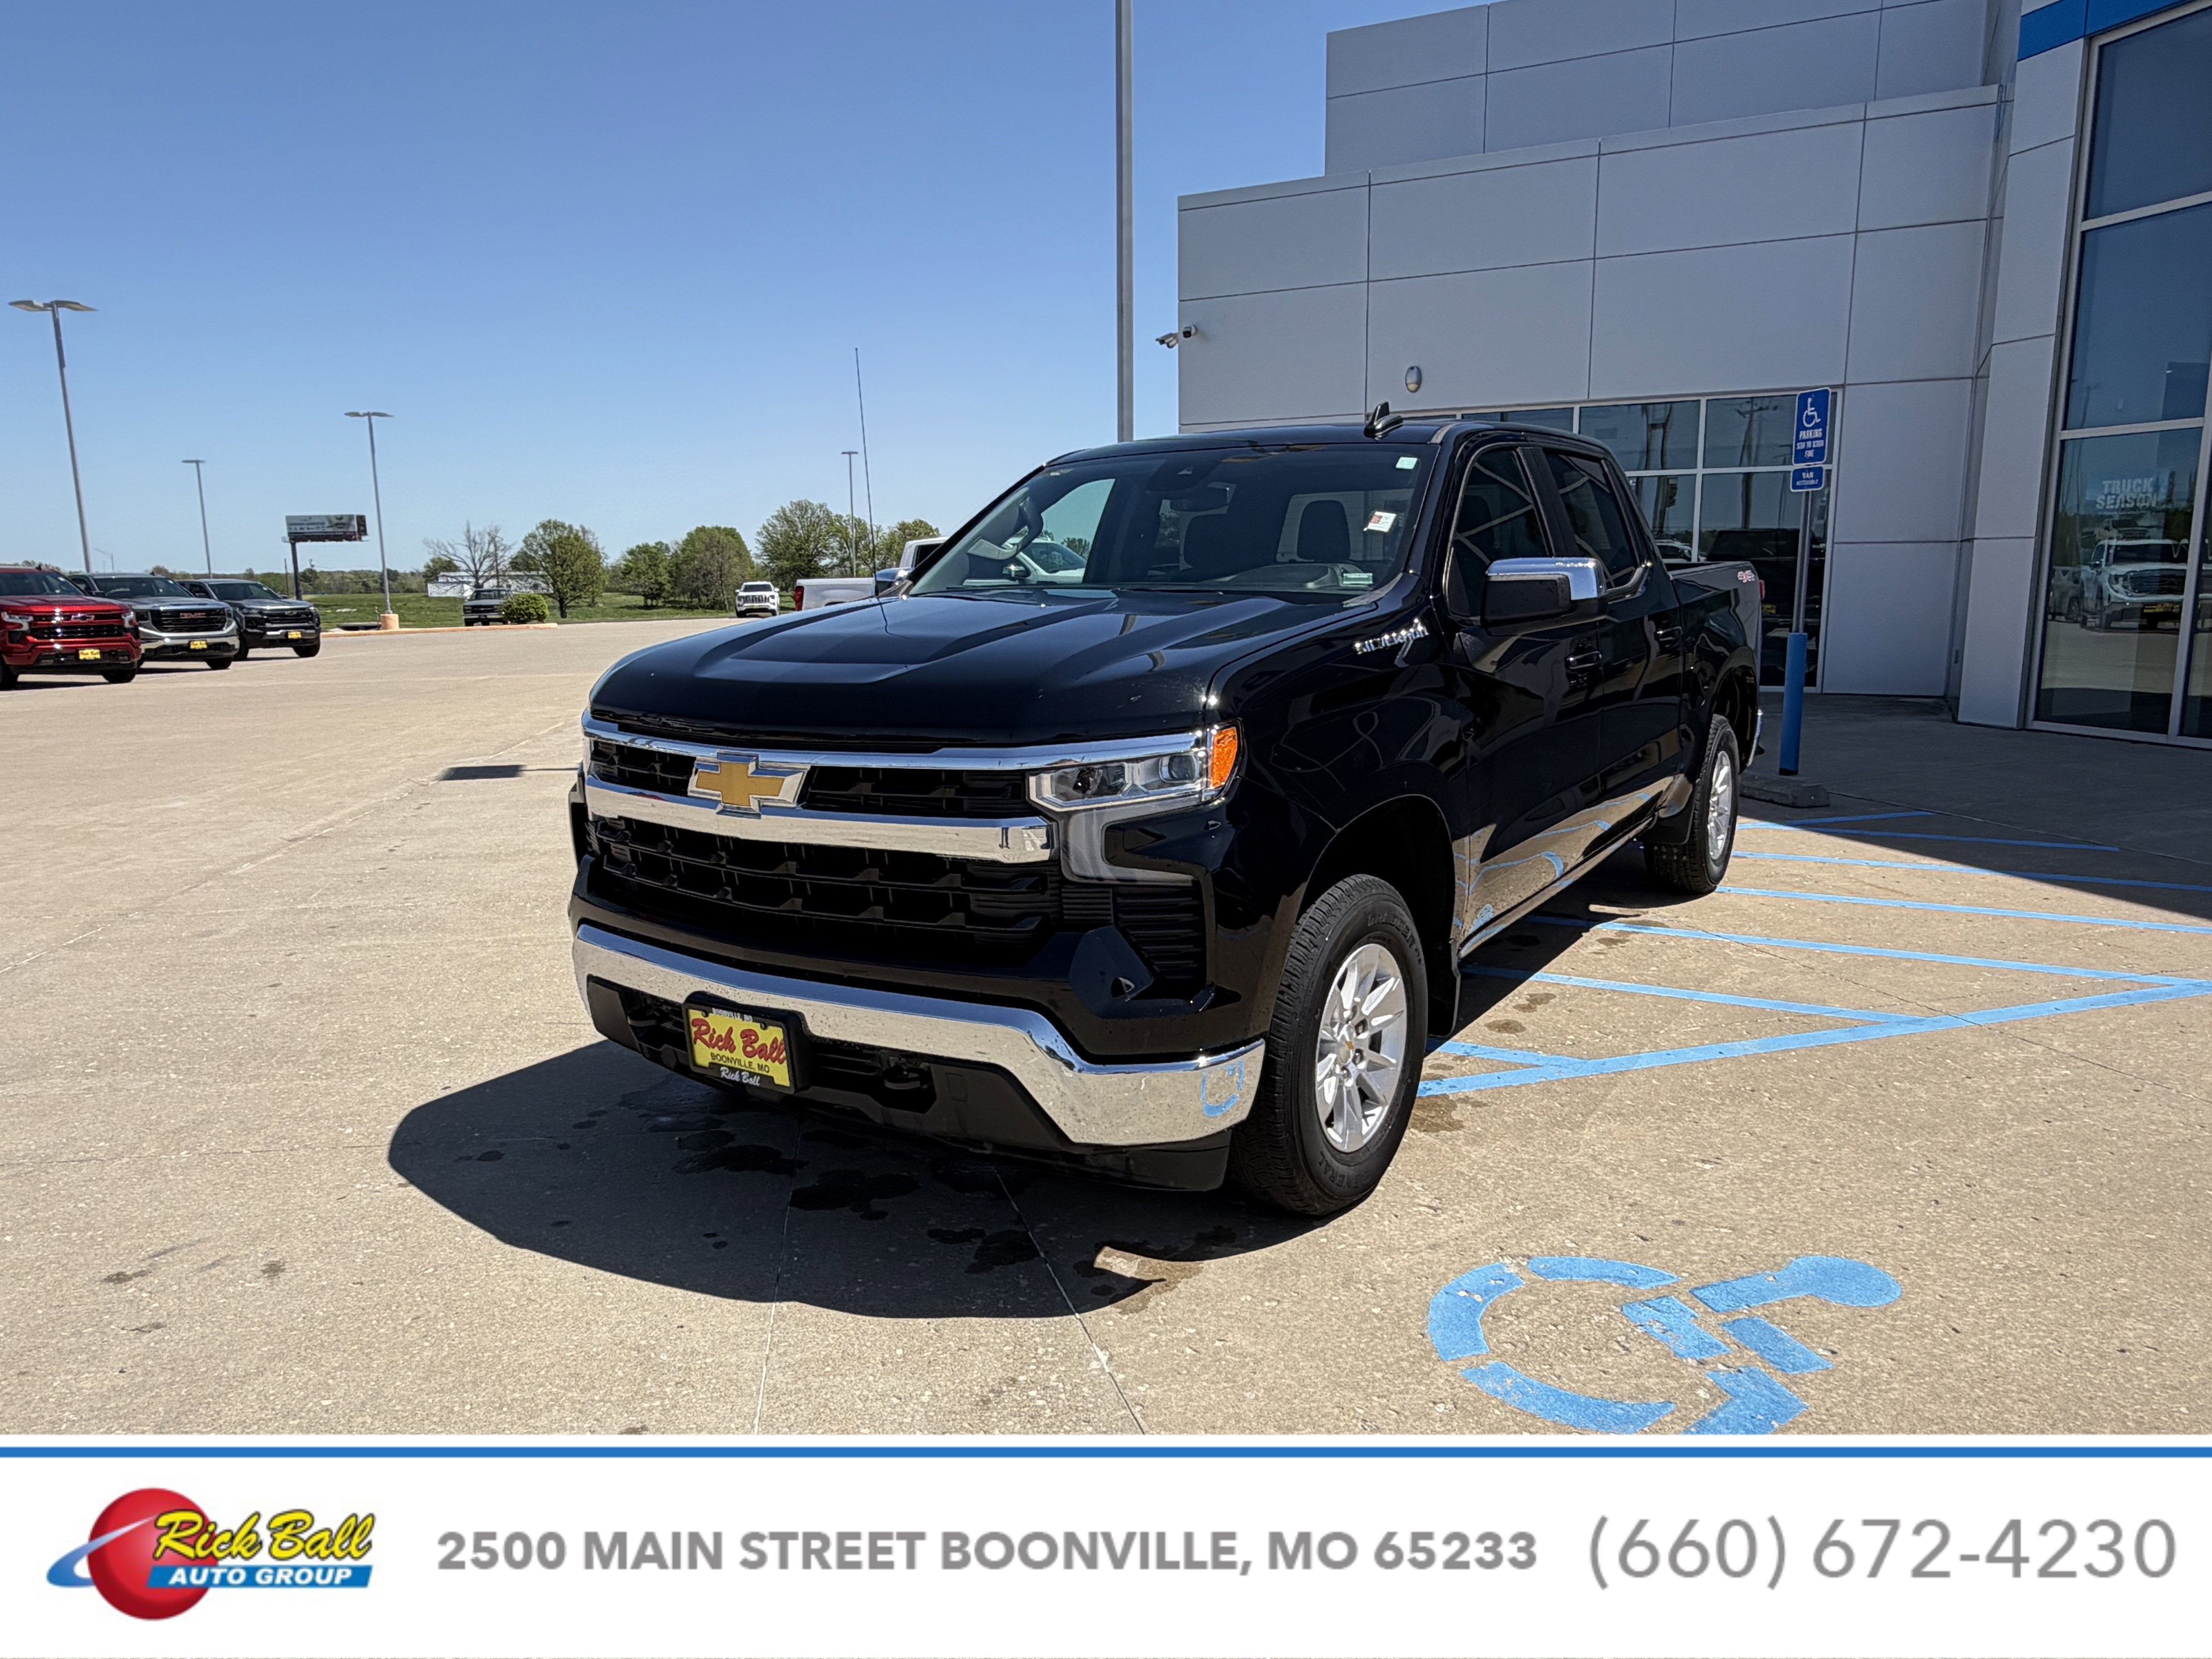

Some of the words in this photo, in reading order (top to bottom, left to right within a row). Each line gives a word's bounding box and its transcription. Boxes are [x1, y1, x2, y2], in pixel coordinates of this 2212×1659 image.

[1799, 428, 1822, 440] PARKING
[2102, 478, 2154, 494] TRUCK
[2095, 493, 2157, 509] SEASON
[691, 1018, 736, 1054] Rick
[740, 1029, 787, 1065] Ball
[720, 1066, 740, 1082] Rick
[741, 1071, 761, 1086] Ball
[757, 1063, 770, 1073] MO
